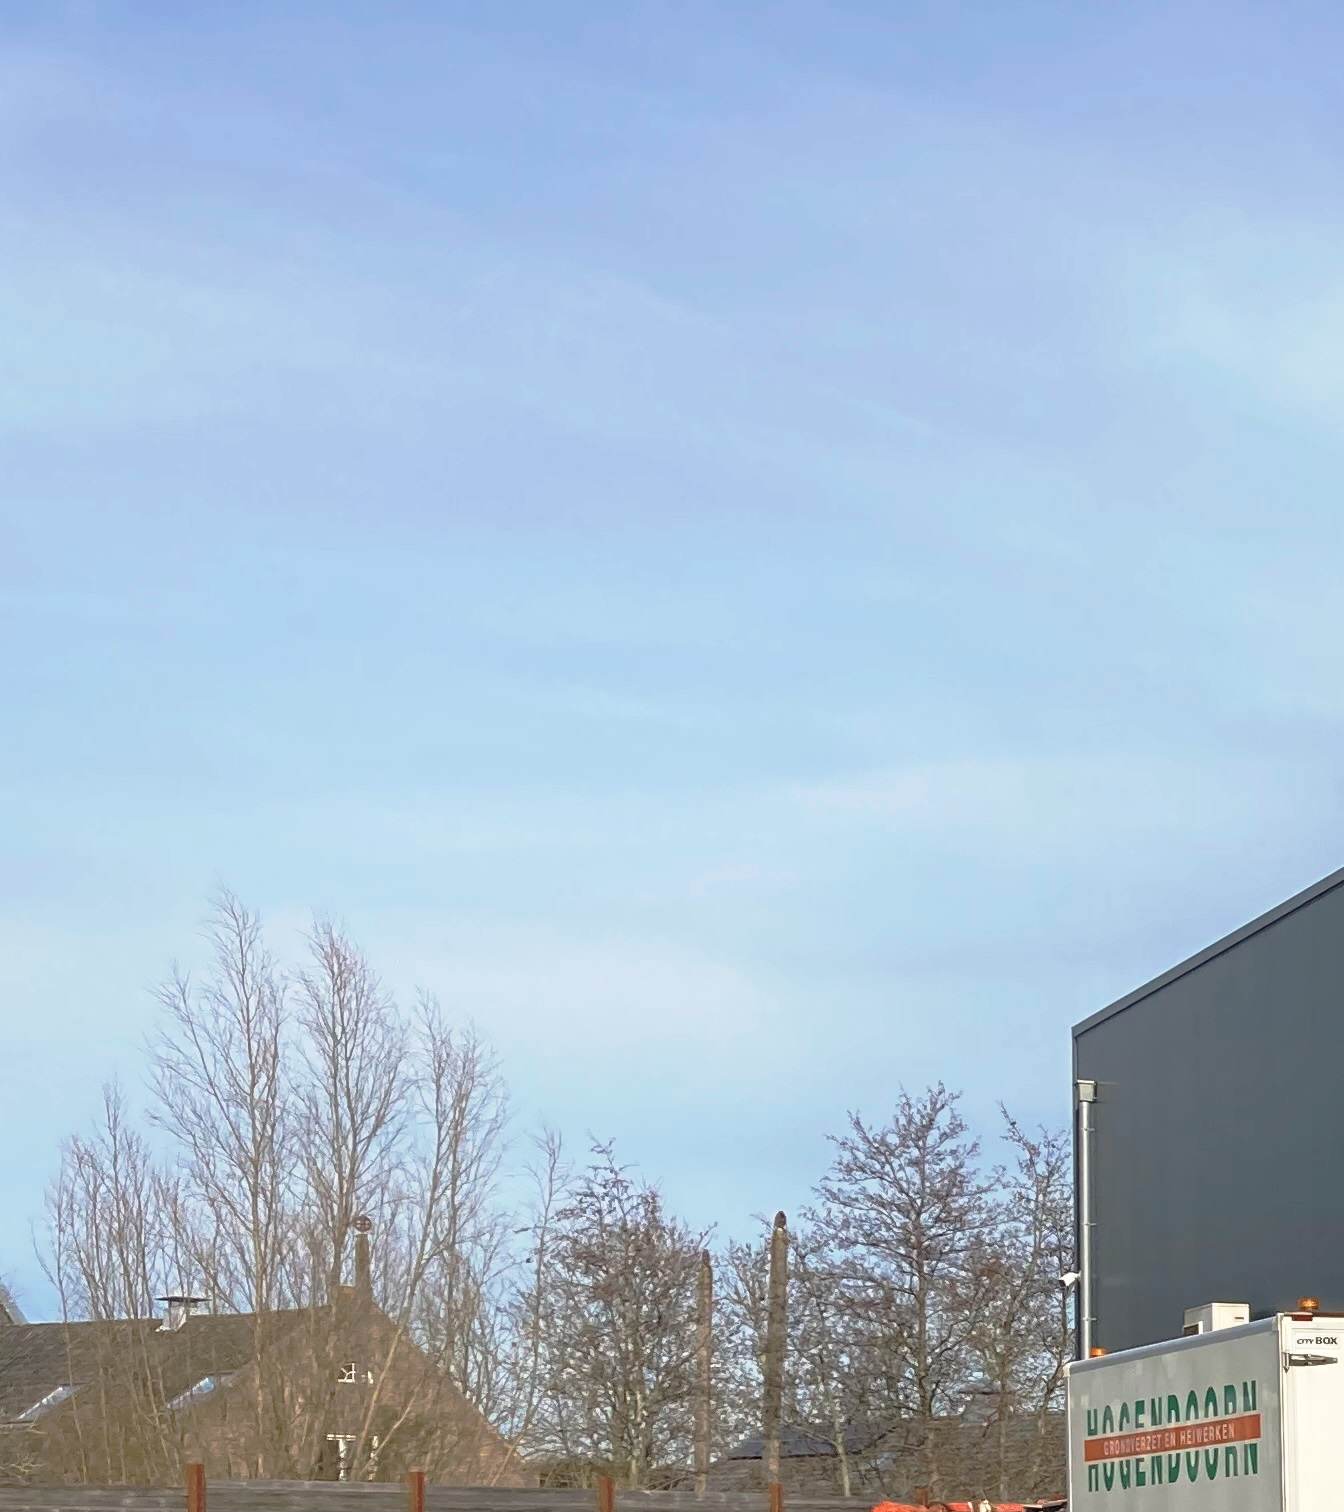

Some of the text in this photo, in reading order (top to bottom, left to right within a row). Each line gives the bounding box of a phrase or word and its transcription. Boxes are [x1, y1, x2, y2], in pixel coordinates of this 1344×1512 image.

[1315, 1336, 1338, 1345] BOX
[1087, 1380, 1259, 1492] HOGENDOORN
[1103, 1422, 1236, 1456] GRONDVERZET EN HEIWERKEN
